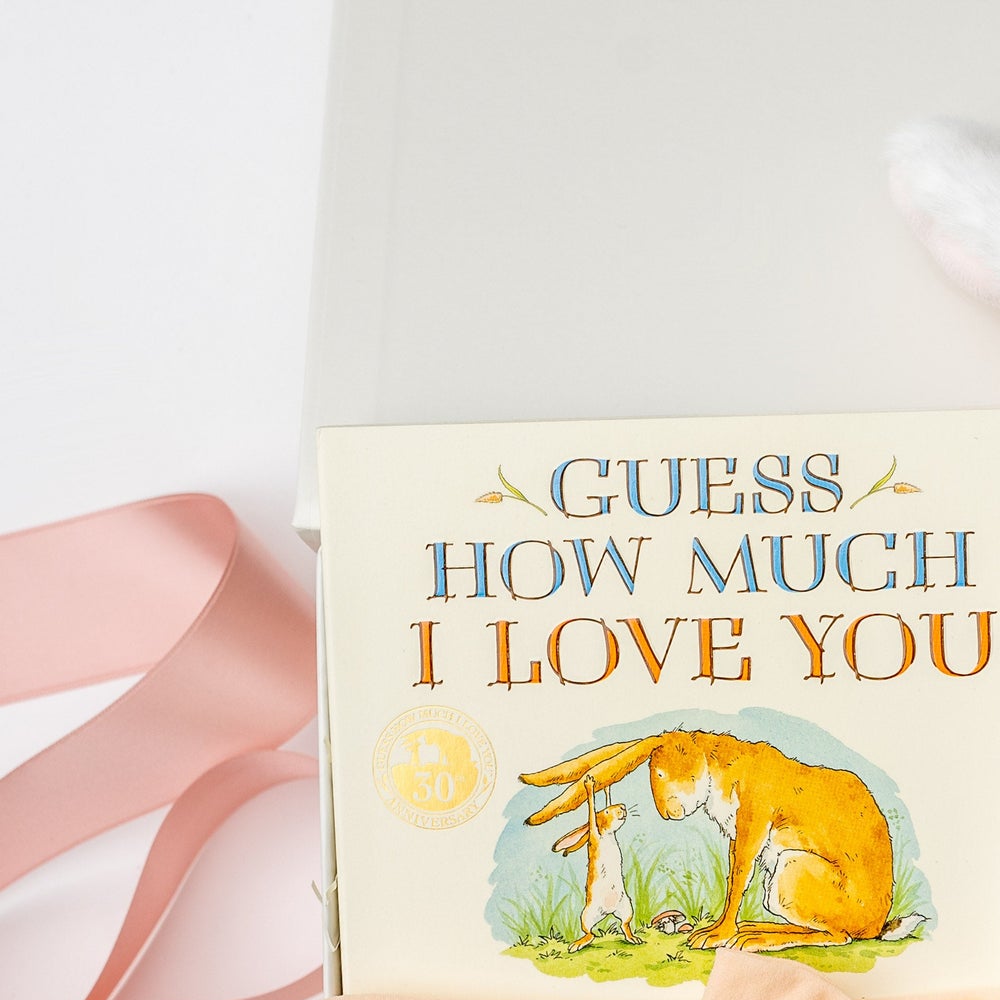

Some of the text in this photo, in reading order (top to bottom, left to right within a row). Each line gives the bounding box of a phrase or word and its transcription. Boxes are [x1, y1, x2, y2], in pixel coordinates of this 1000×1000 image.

[549, 454, 843, 519] GUESS
[426, 531, 976, 603] HOW MUCH
[410, 611, 998, 691] I LOVE YOU
[385, 796, 480, 828] ANNIVERSARY
